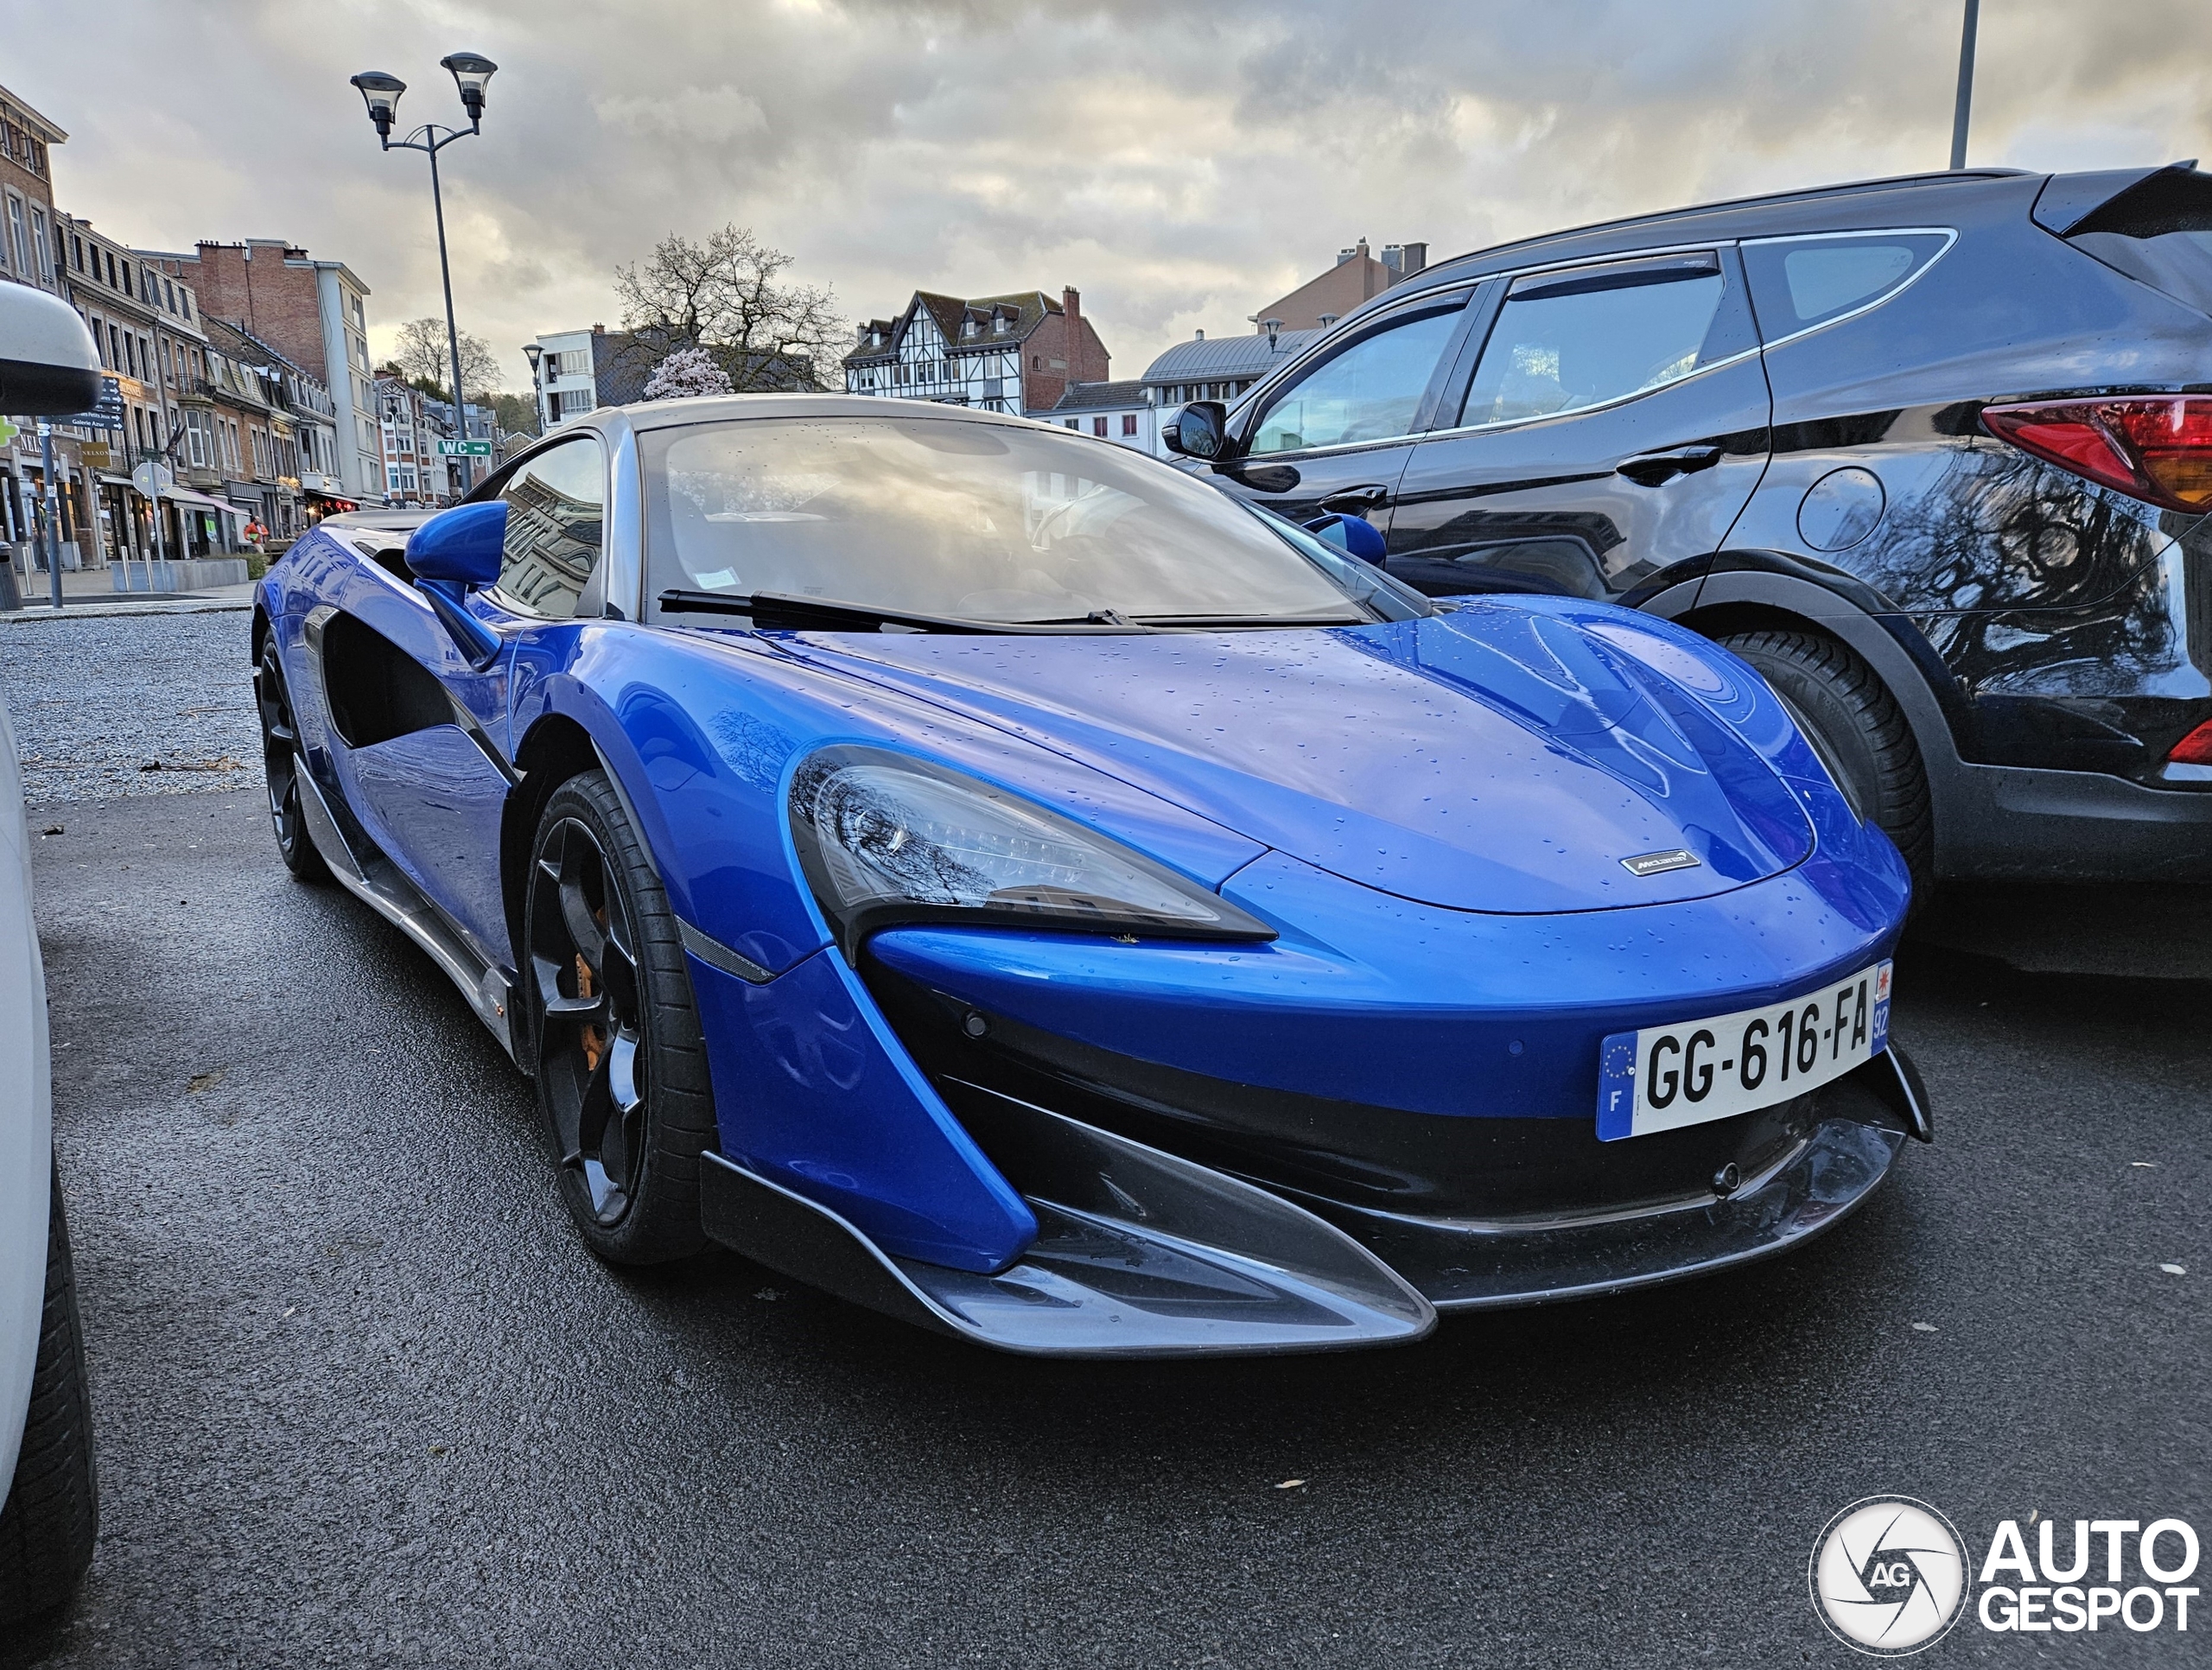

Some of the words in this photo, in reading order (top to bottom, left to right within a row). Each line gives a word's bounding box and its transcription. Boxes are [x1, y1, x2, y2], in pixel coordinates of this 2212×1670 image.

[20, 434, 57, 455] NELSN
[442, 441, 467, 454] WC
[1637, 854, 1688, 870] McLaren
[1873, 1006, 1889, 1039] 92
[1647, 979, 1867, 1109] GG-616-FA
[1610, 1090, 1623, 1112] F
